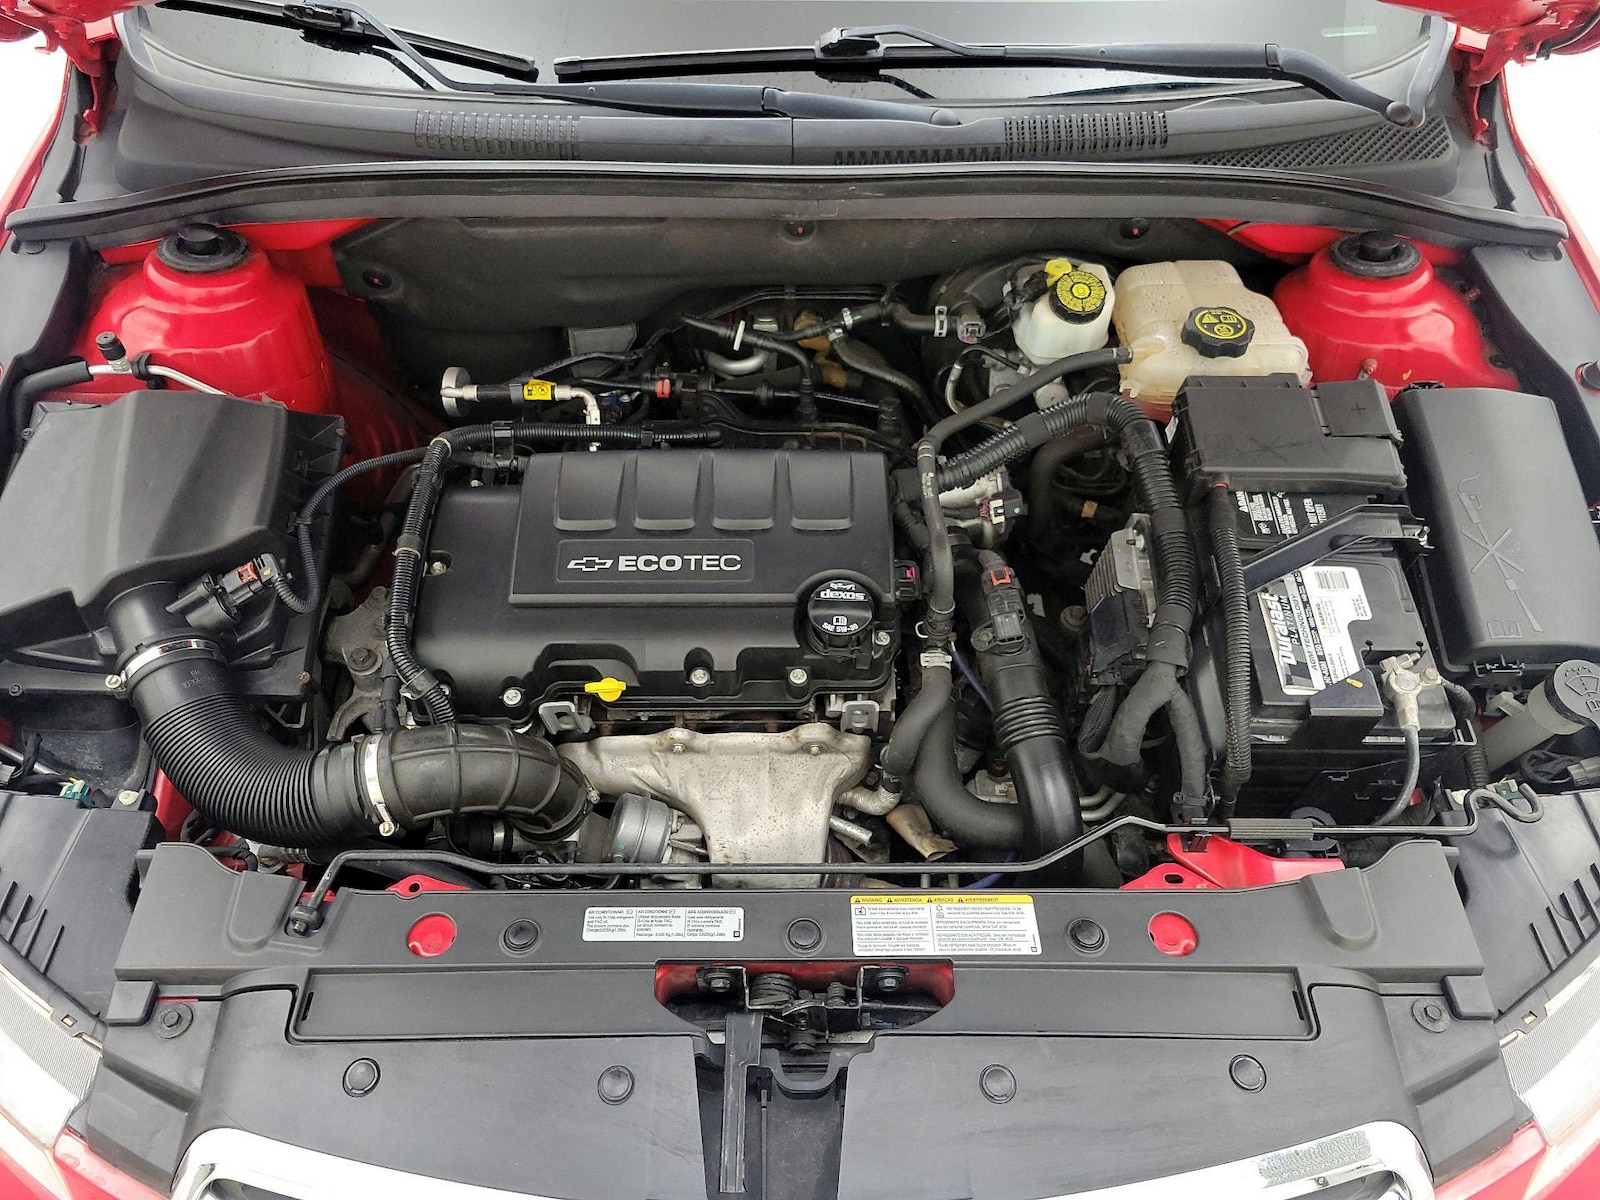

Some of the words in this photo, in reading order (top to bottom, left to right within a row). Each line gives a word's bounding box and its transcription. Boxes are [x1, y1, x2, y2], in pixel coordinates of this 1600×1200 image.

[618, 555, 742, 571] ECOTEC
[820, 589, 866, 600] dexos
[1260, 592, 1298, 665] Duralast
[1279, 595, 1301, 646] PLATINUM
[1291, 594, 1312, 649] TECHNOLOGY
[1308, 650, 1318, 671] AGM
